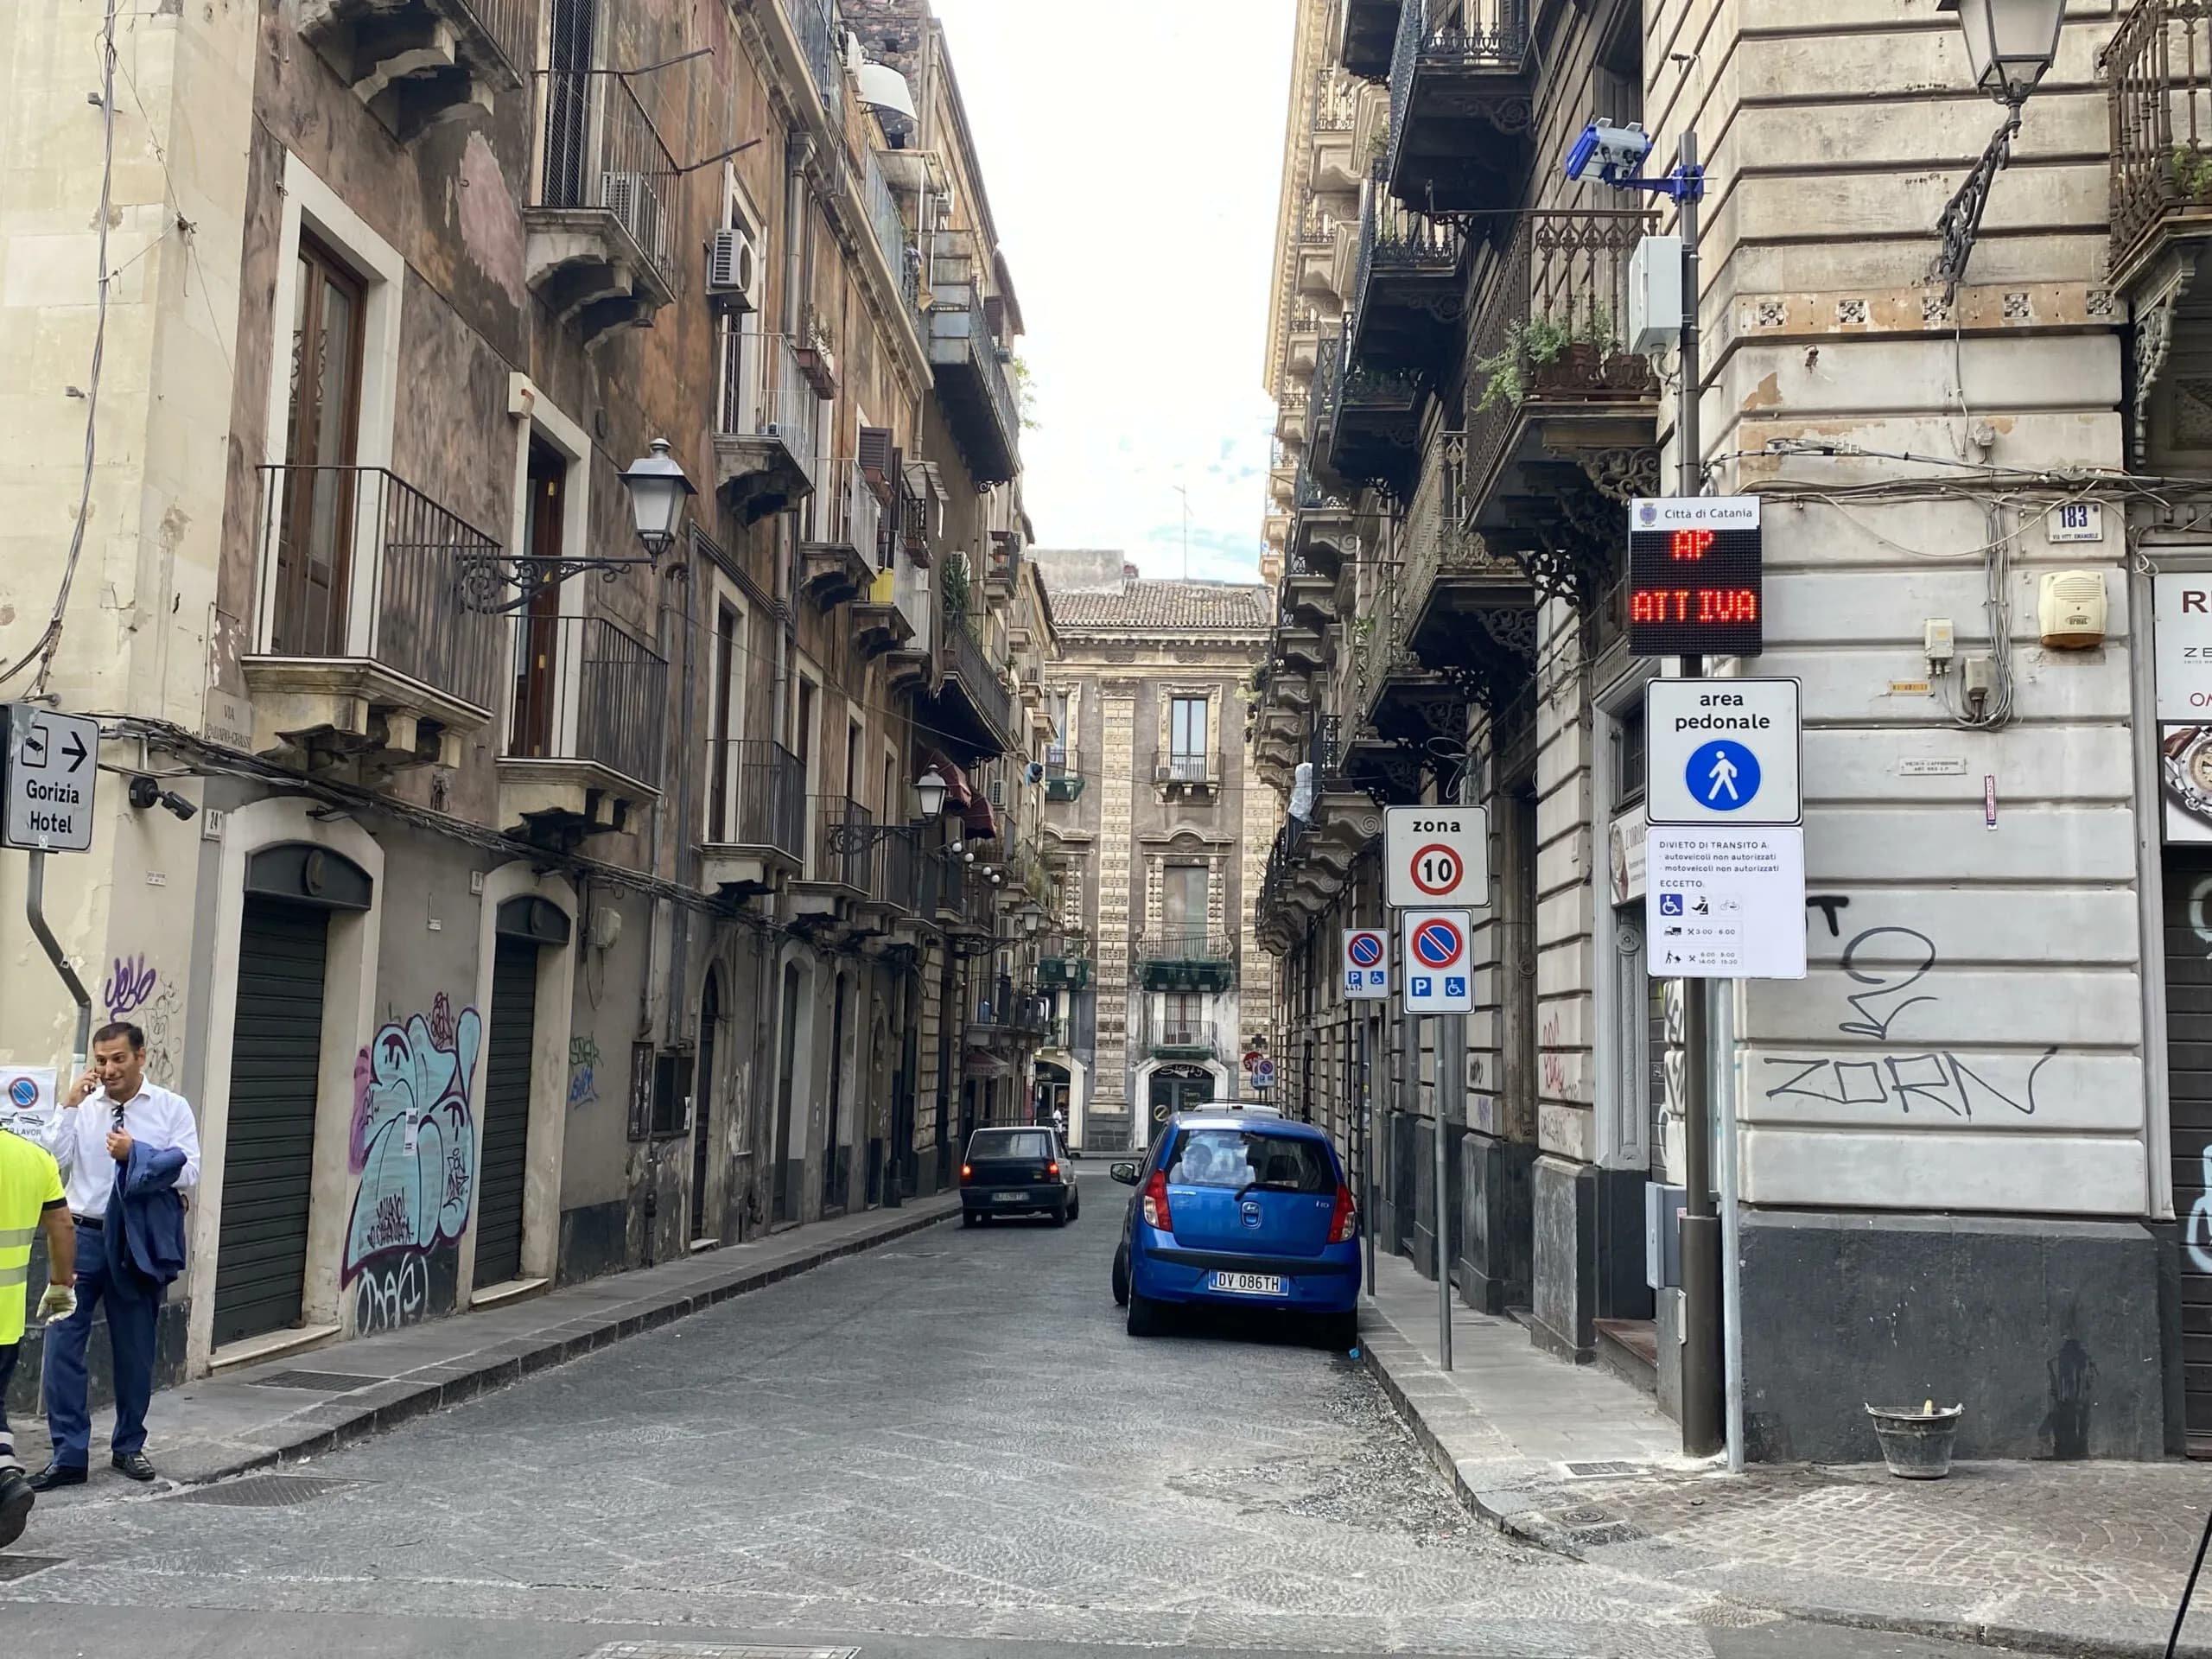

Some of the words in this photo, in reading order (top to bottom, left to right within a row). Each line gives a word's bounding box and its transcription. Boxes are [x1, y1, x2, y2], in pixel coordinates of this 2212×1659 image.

[1665, 509, 1692, 518] Città
[1695, 508, 1706, 518] di
[1710, 508, 1752, 518] Catania
[2059, 505, 2088, 528] 183
[1673, 529, 1714, 560] AP
[1632, 589, 1756, 622] ATTIVA
[2183, 591, 2212, 613] R
[1700, 694, 1744, 707] area
[1675, 714, 1770, 732] pedonale
[27, 779, 79, 804] Gorizia
[30, 810, 73, 834] Hotel
[1413, 821, 1461, 833] zona
[1424, 858, 1452, 882] 10
[1351, 972, 1360, 983] P
[1415, 980, 1427, 994] P
[17, 1127, 41, 1136] LAVOR
[1218, 1273, 1235, 1287] DV
[1239, 1275, 1280, 1291] 086TH
